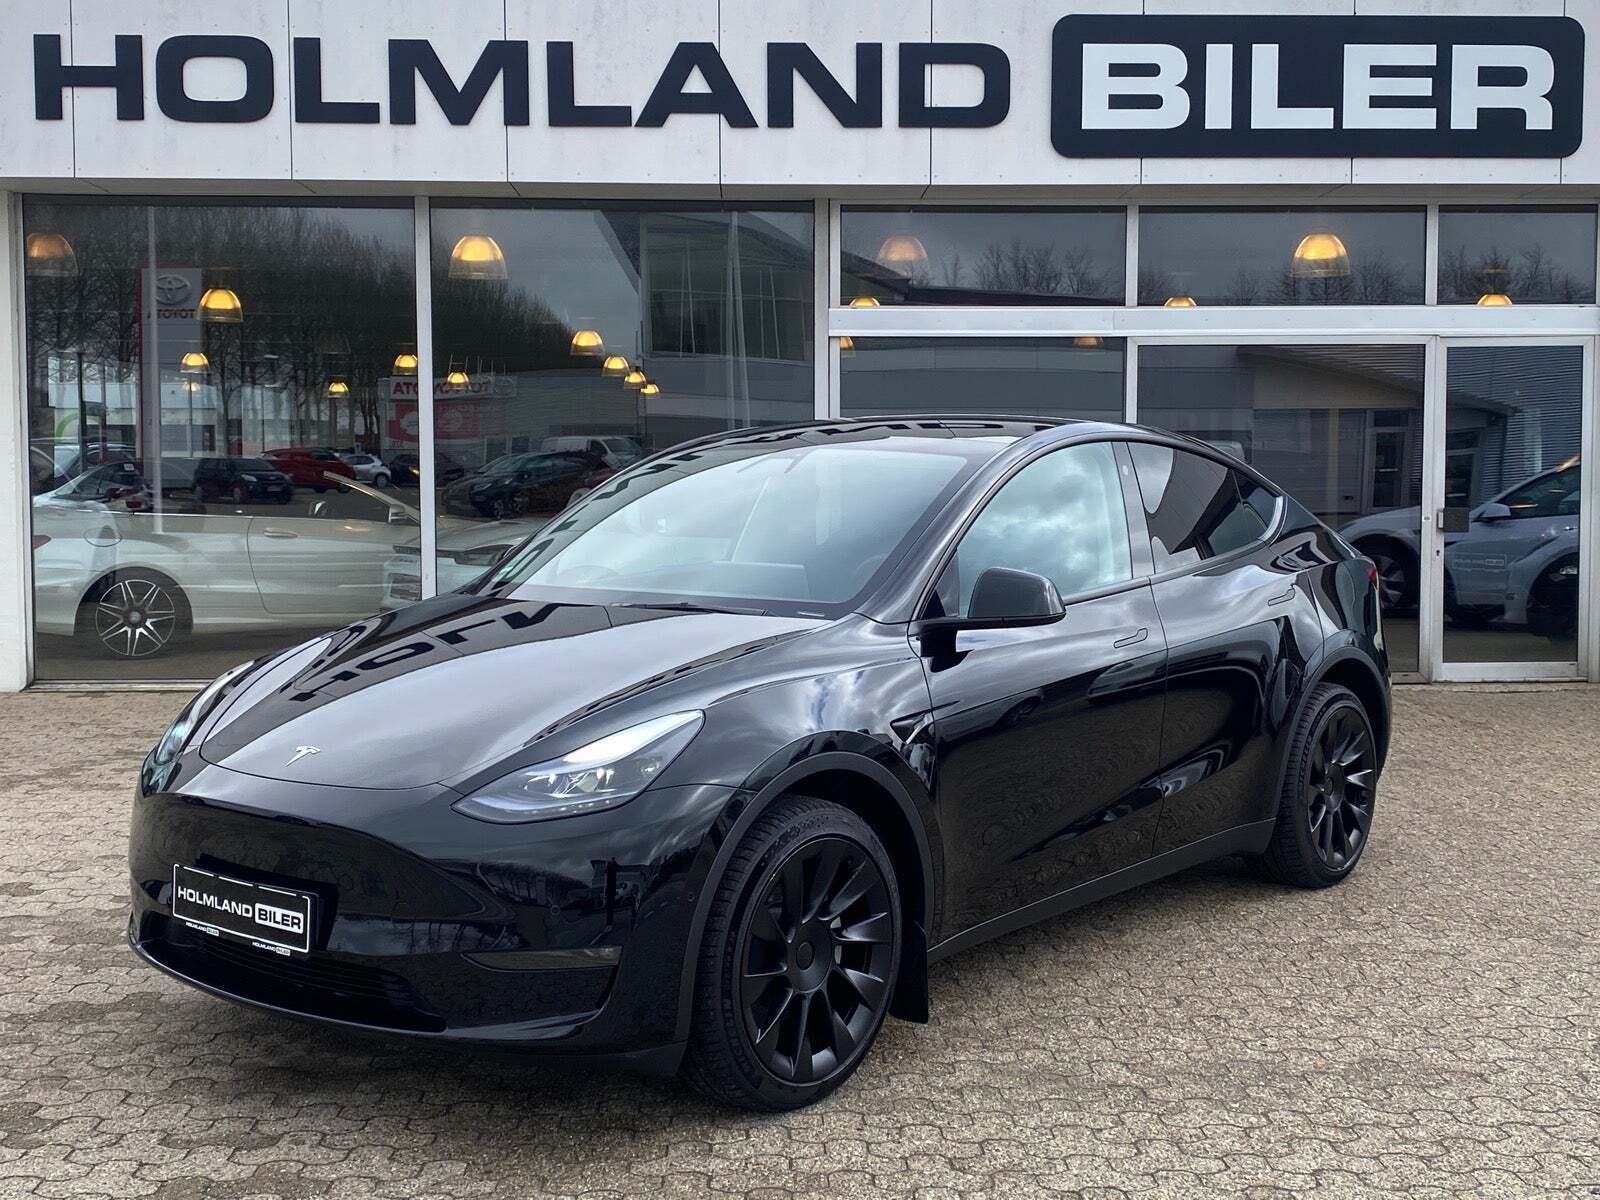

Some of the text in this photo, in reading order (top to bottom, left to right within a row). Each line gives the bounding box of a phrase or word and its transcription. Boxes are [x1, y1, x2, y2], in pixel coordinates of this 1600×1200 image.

[33, 34, 1555, 130] HOLMLAND BILER
[178, 886, 301, 930] HOLMLAND BILER
